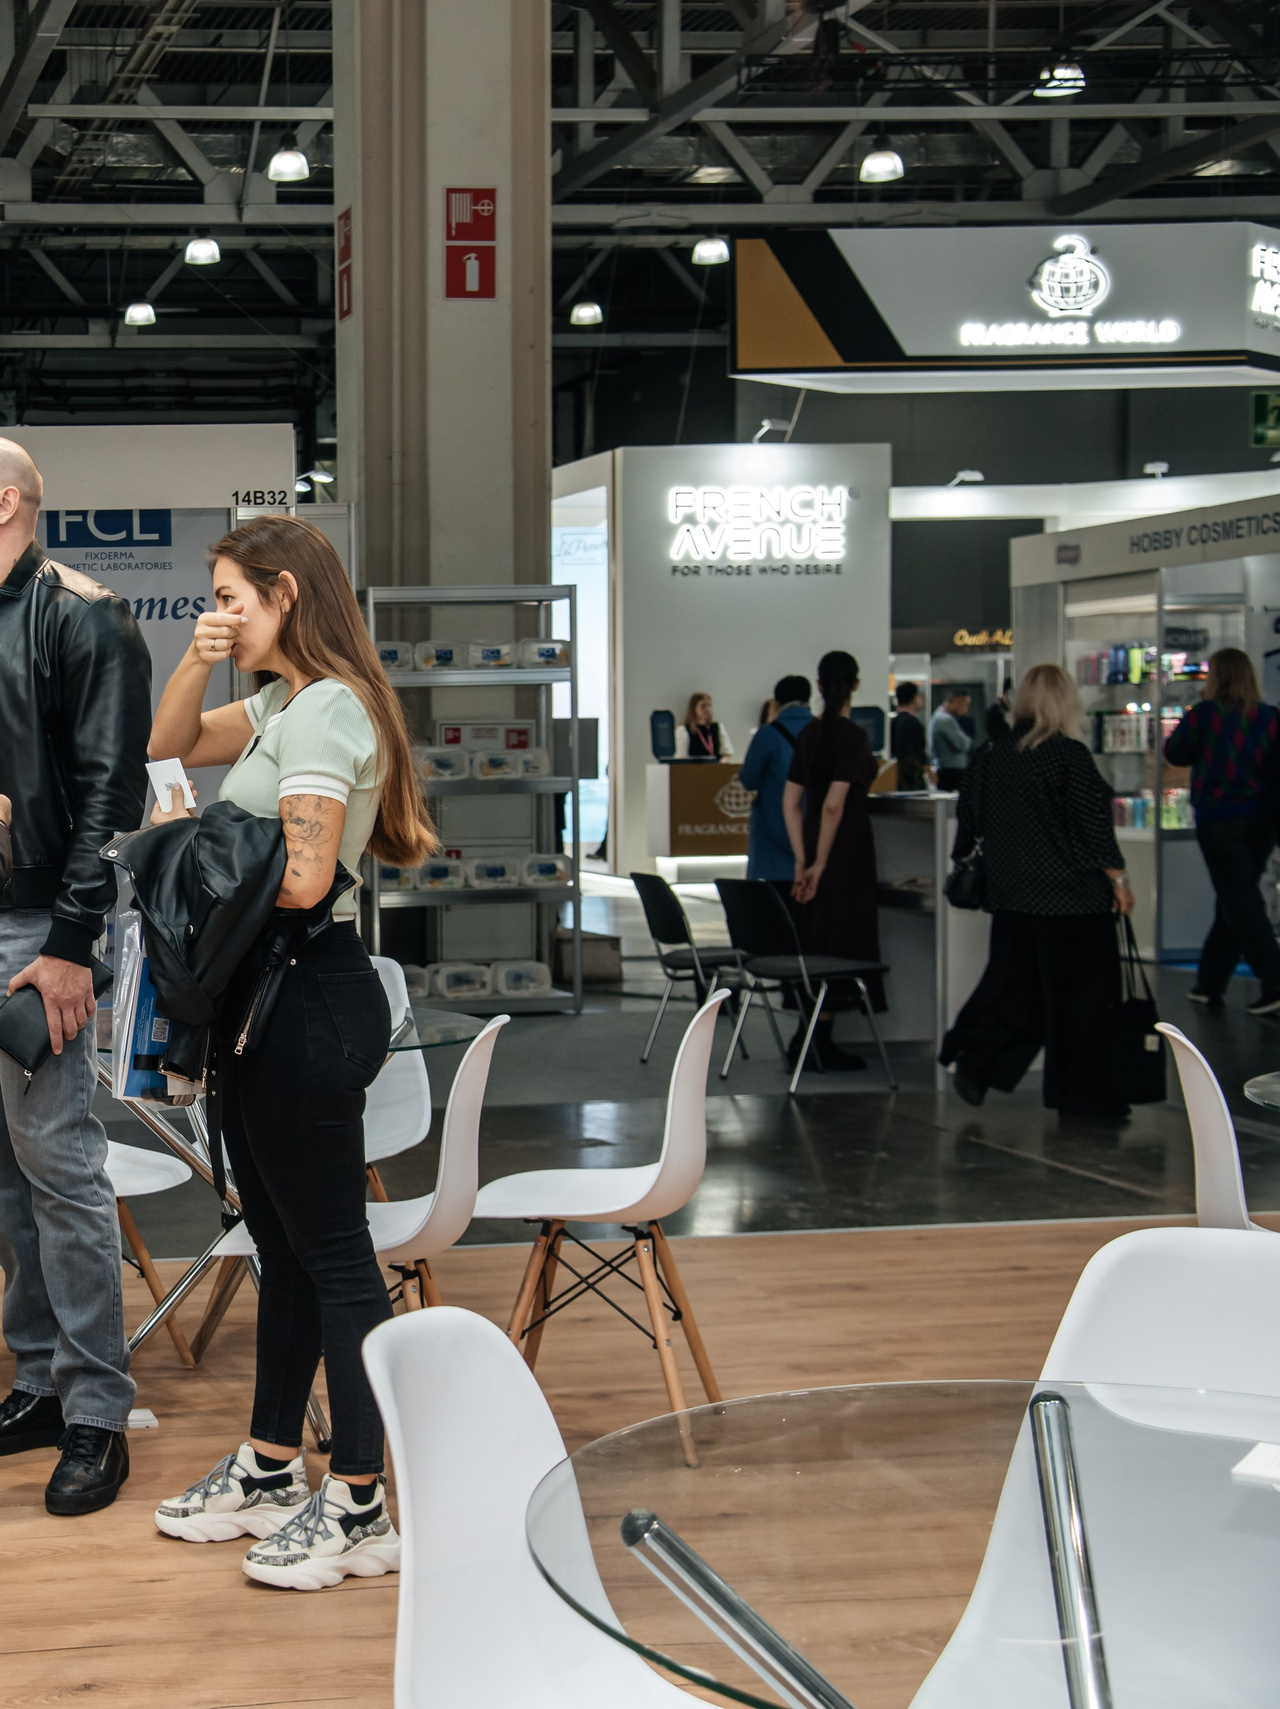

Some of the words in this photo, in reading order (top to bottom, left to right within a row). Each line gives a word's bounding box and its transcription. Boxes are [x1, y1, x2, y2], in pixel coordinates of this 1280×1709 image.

[1093, 318, 1181, 344] WORLD
[231, 490, 288, 506] 14B32
[672, 487, 845, 522] FRENCH
[58, 508, 160, 542] FCL
[672, 525, 844, 559] AVENUE
[1128, 527, 1184, 555] HOBBY
[65, 562, 98, 572] METIC
[100, 561, 173, 571] LABORATORIES
[84, 551, 135, 561] FIXDERMA
[671, 564, 701, 577] FOR
[706, 564, 752, 576] THOSE
[757, 564, 791, 575] WHO
[795, 563, 843, 575] DESIRE
[122, 596, 207, 621] mes
